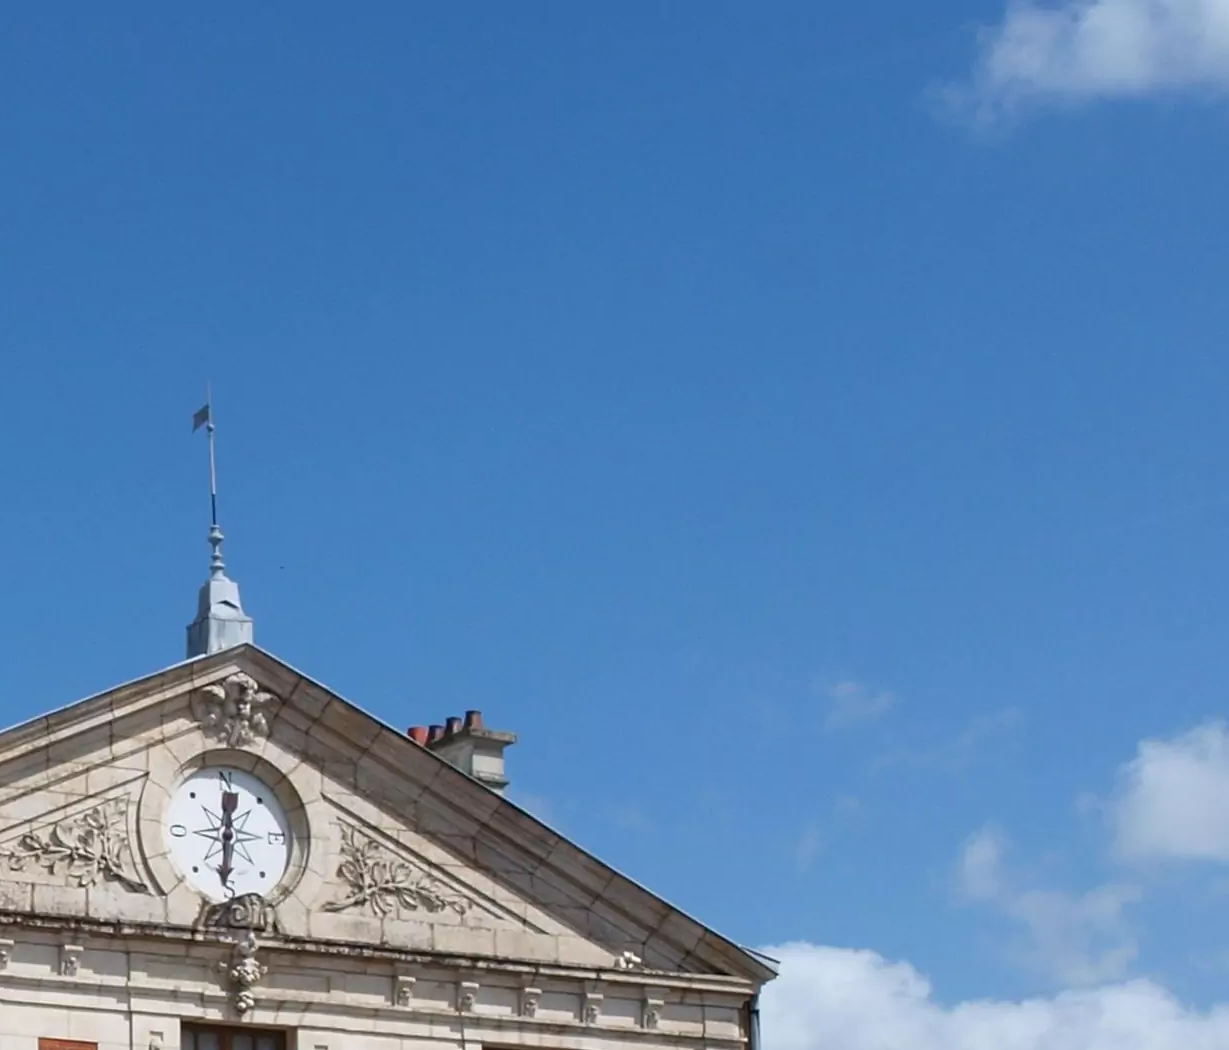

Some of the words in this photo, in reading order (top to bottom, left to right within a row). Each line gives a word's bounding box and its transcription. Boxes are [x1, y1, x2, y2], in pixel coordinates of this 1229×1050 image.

[219, 771, 233, 791] N
[169, 824, 187, 838] O
[267, 831, 285, 845] E
[223, 880, 236, 899] S
